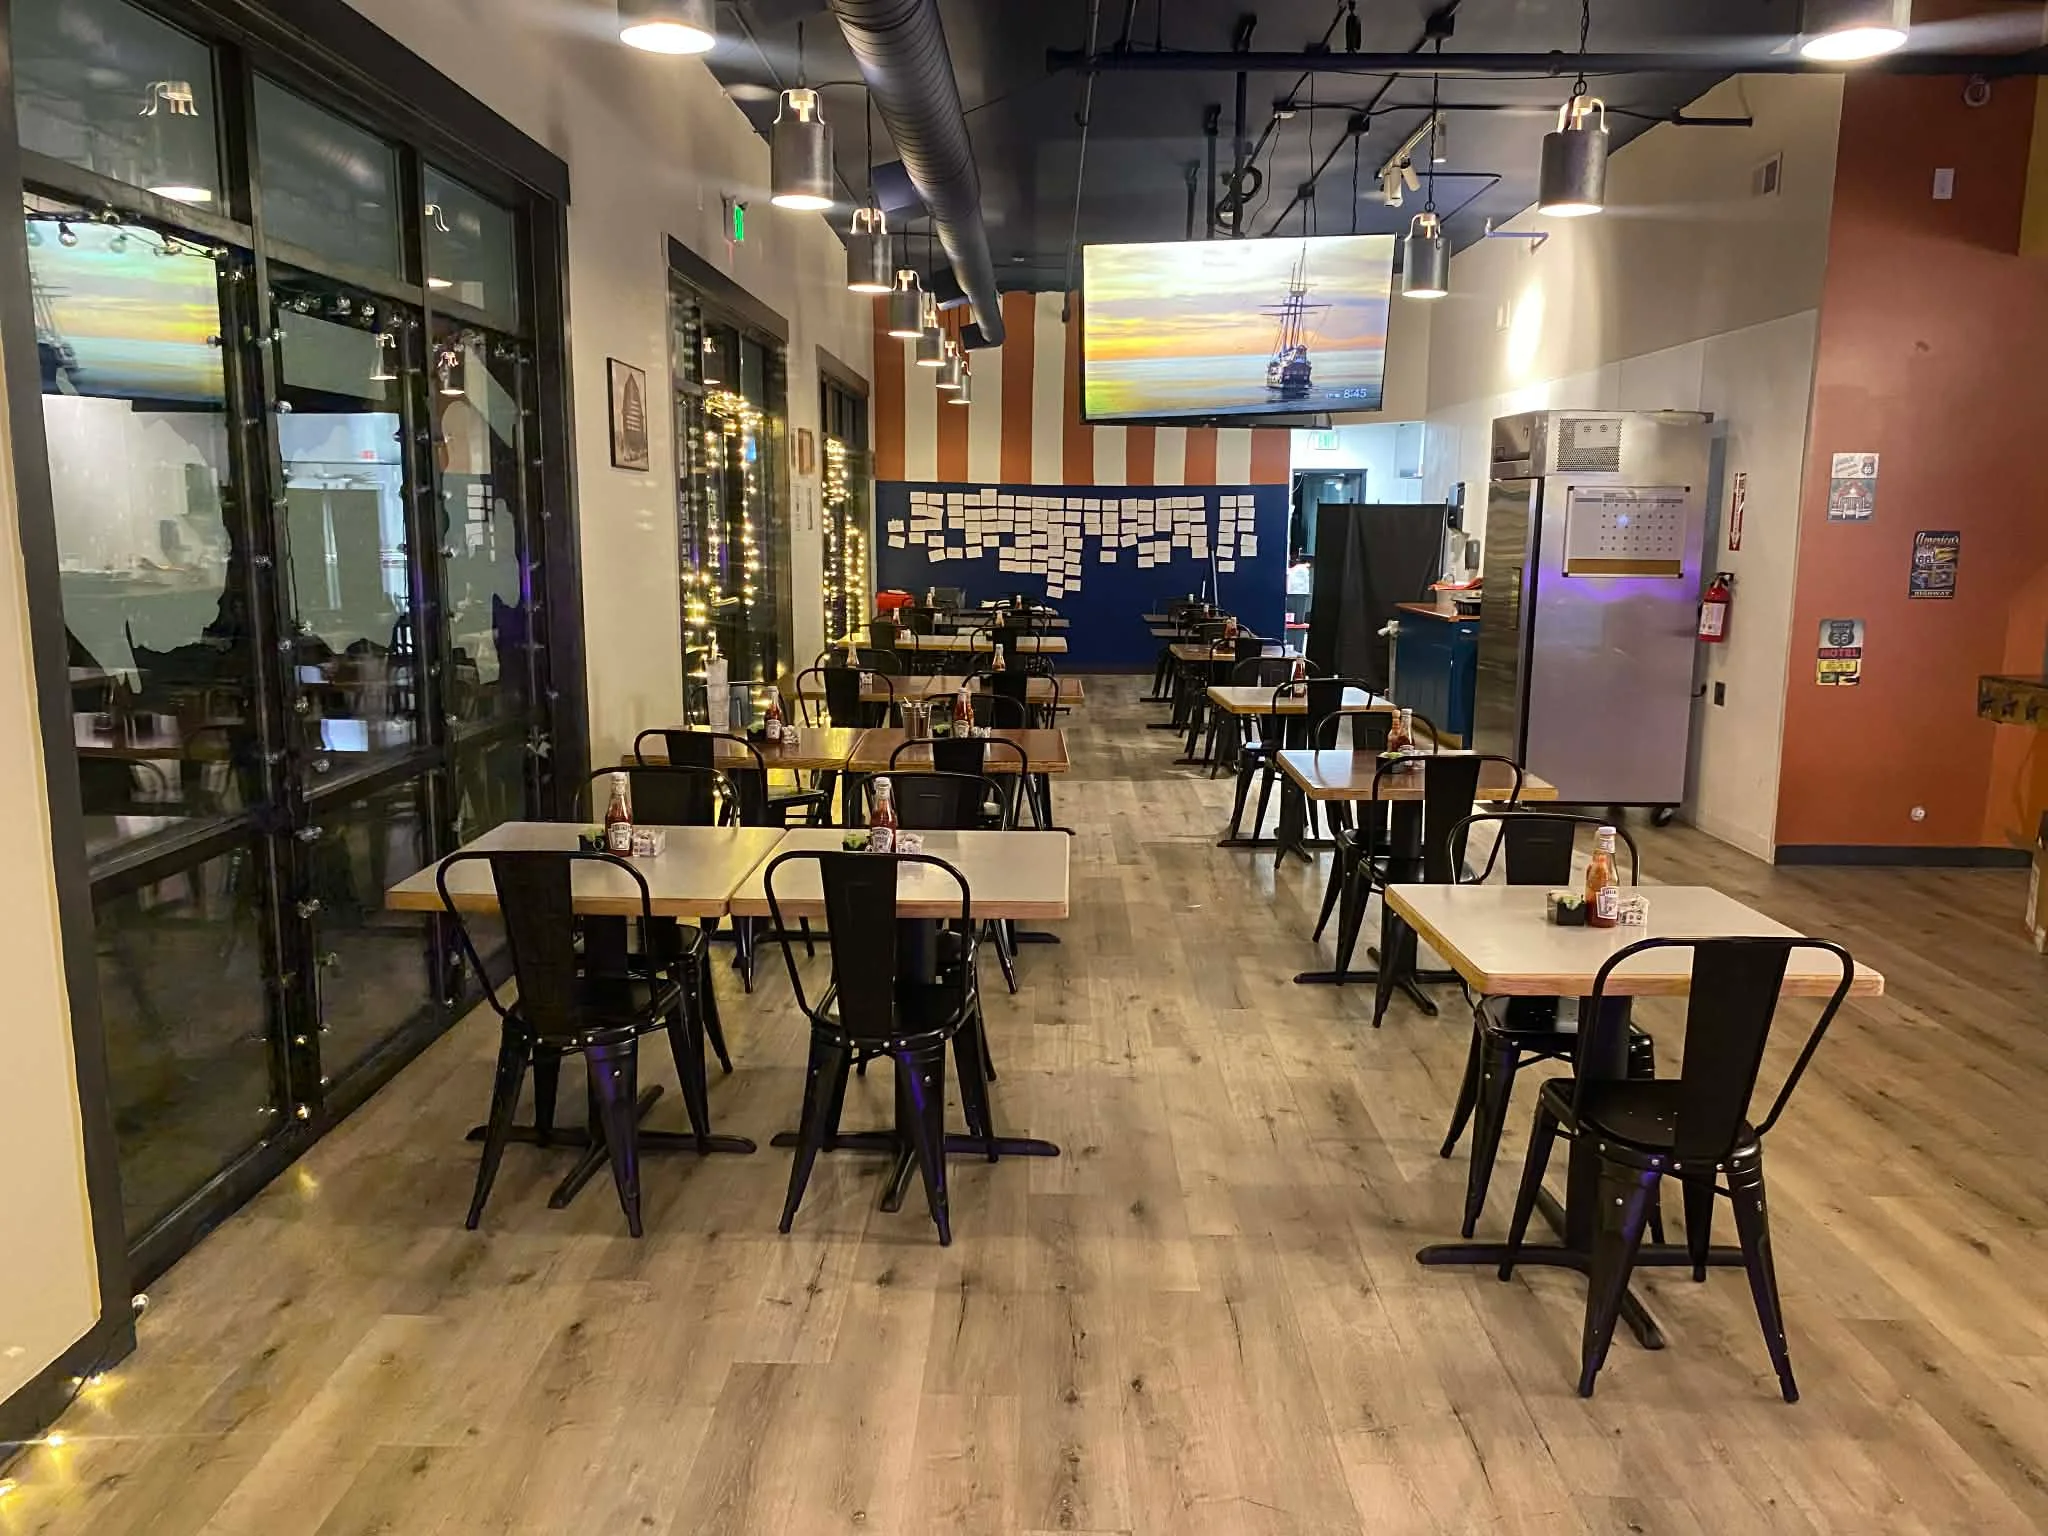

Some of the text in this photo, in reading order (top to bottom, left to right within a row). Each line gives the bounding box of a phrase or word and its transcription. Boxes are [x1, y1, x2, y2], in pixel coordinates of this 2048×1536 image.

[1344, 388, 1367, 399] 8:45
[1832, 633, 1850, 645] 66
[1820, 648, 1857, 658] MOTEL
